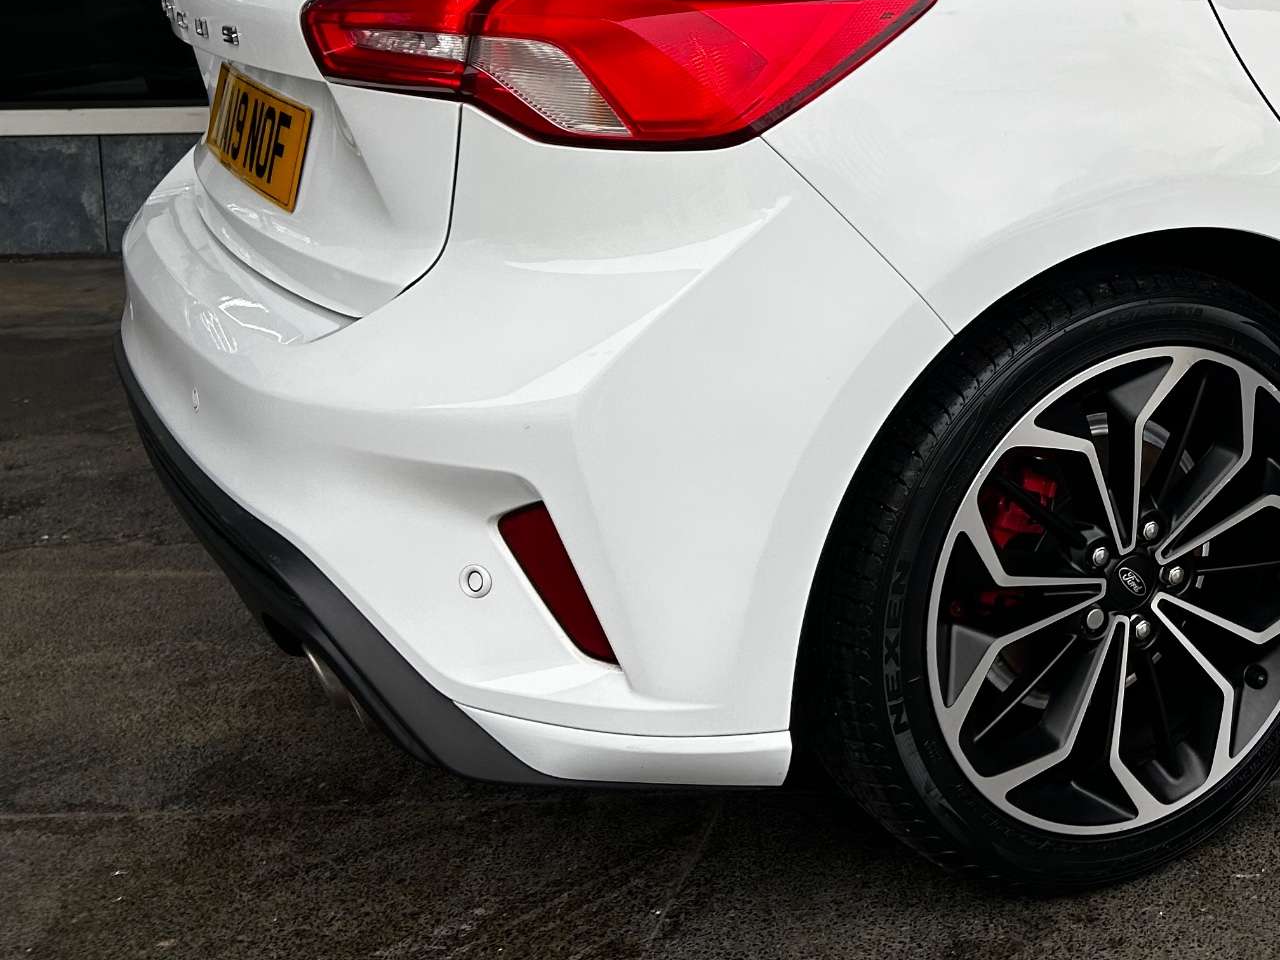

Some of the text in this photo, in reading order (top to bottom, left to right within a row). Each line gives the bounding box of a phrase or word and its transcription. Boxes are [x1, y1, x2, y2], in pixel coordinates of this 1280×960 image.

[242, 98, 292, 184] NOF
[1122, 571, 1143, 593] Ford
[883, 557, 912, 735] NEXEN
